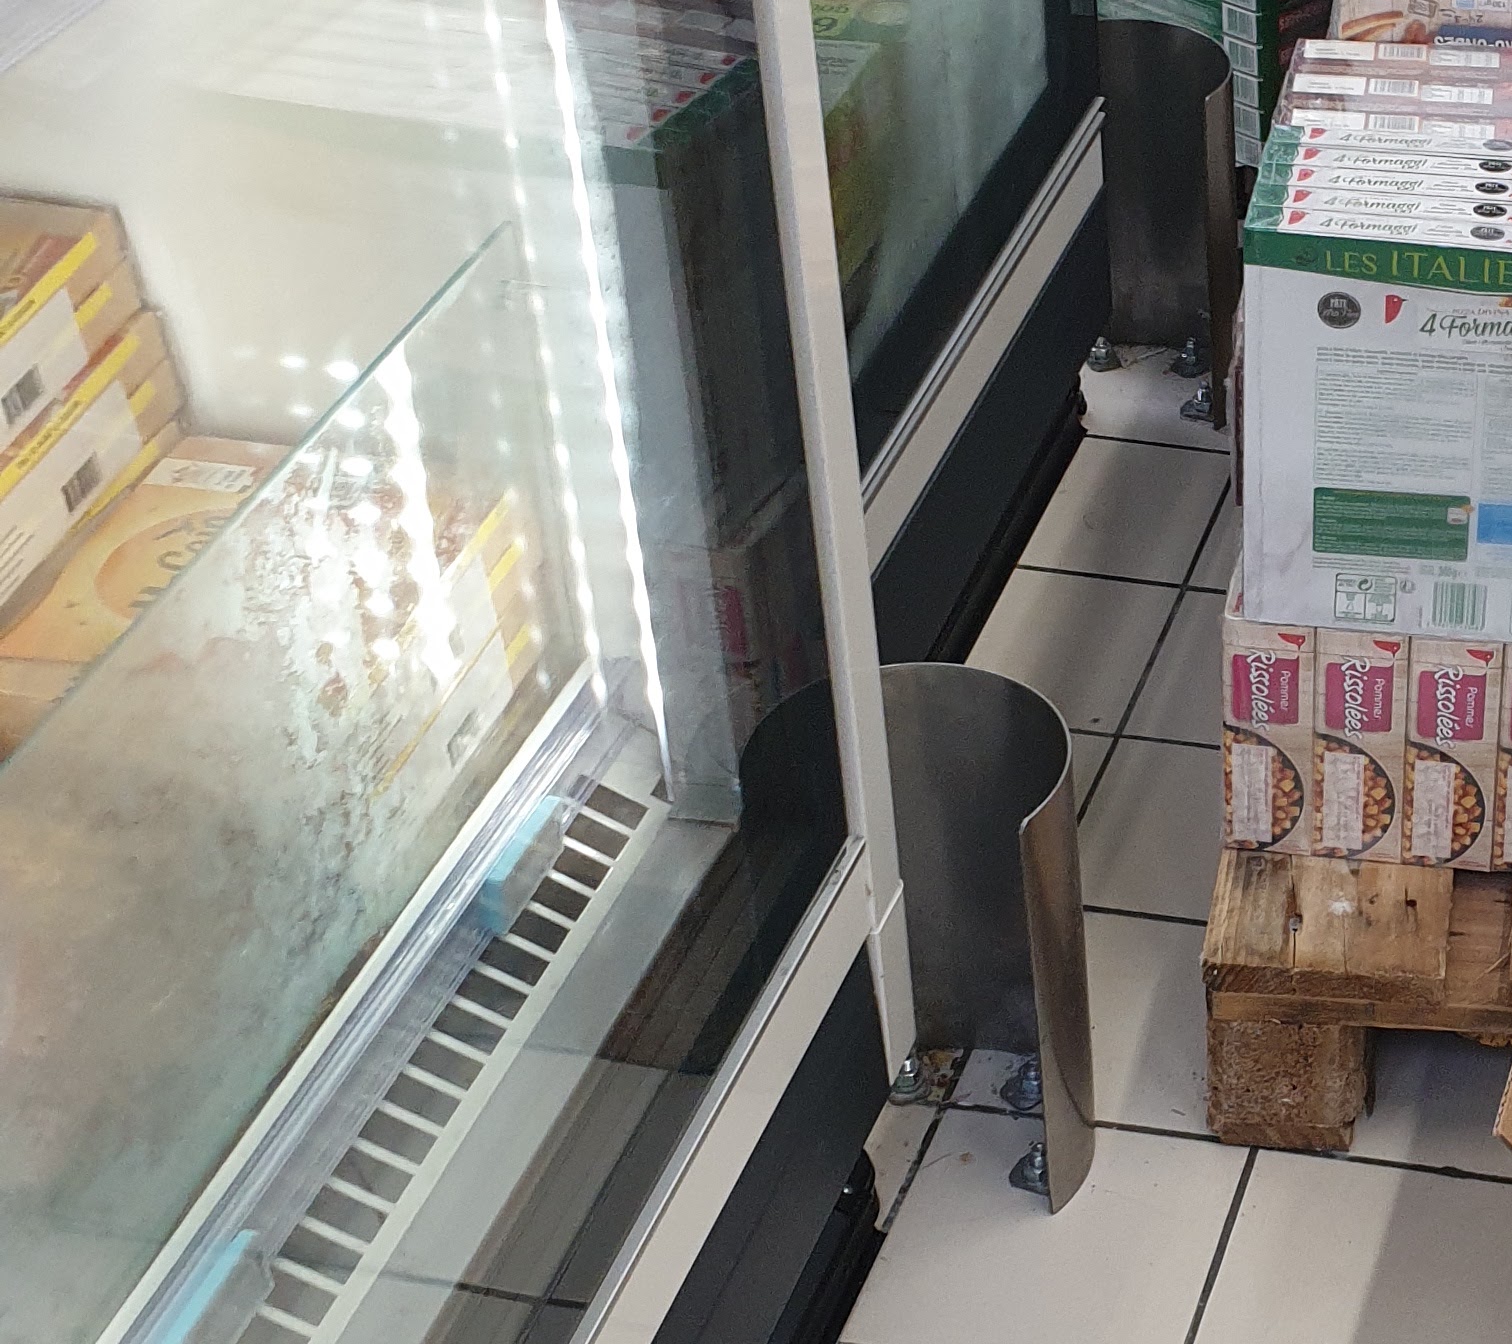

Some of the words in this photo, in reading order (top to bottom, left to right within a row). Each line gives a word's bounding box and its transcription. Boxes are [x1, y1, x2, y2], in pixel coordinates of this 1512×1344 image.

[1325, 250, 1377, 276] LES
[1419, 313, 1437, 337] 4
[1246, 648, 1276, 733] Rissolées
[1279, 670, 1291, 712] Pommes
[1340, 656, 1371, 742] Rissolées
[1374, 677, 1386, 720] Pommes
[1434, 664, 1465, 749] Rissolées
[1465, 686, 1478, 729] Pommes
